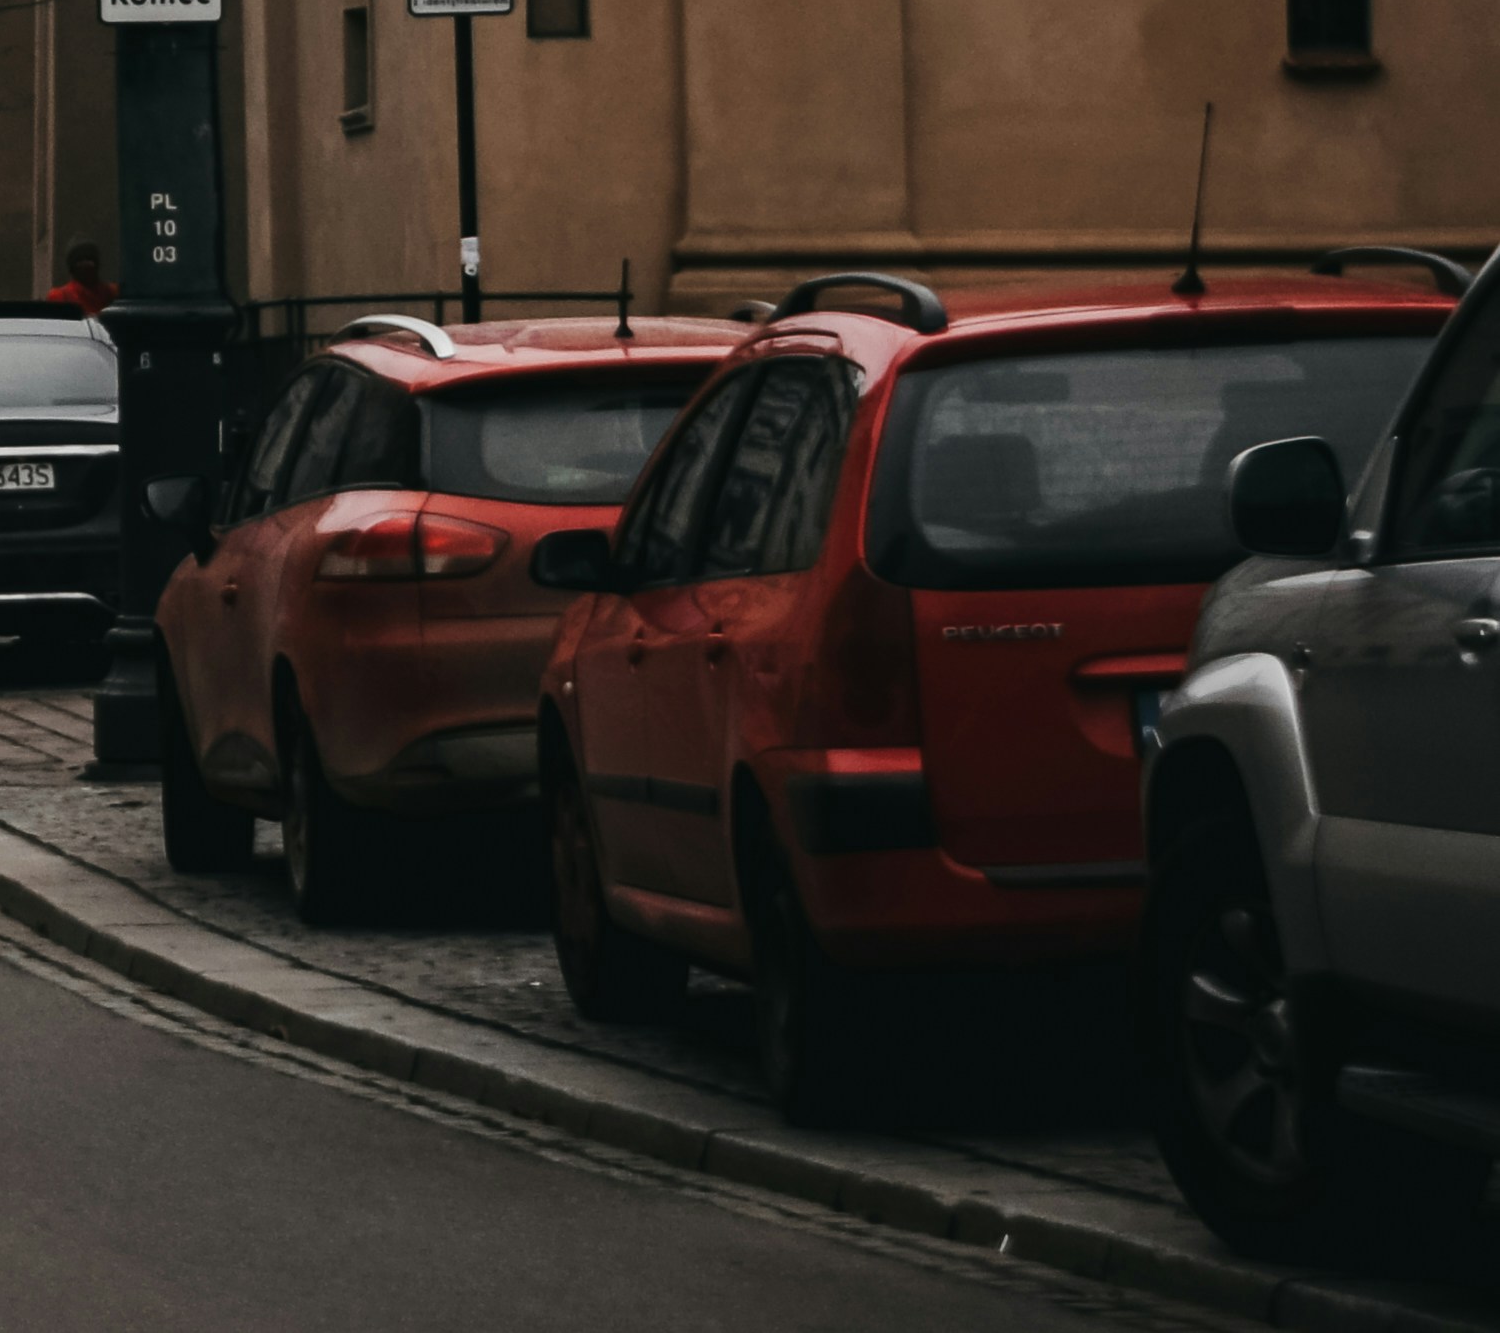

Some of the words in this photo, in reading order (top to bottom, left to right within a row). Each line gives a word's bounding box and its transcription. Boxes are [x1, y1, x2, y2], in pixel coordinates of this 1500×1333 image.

[150, 193, 178, 210] PL
[154, 219, 176, 236] 10
[153, 245, 176, 263] 03
[941, 622, 1064, 640] PEUGEOT
